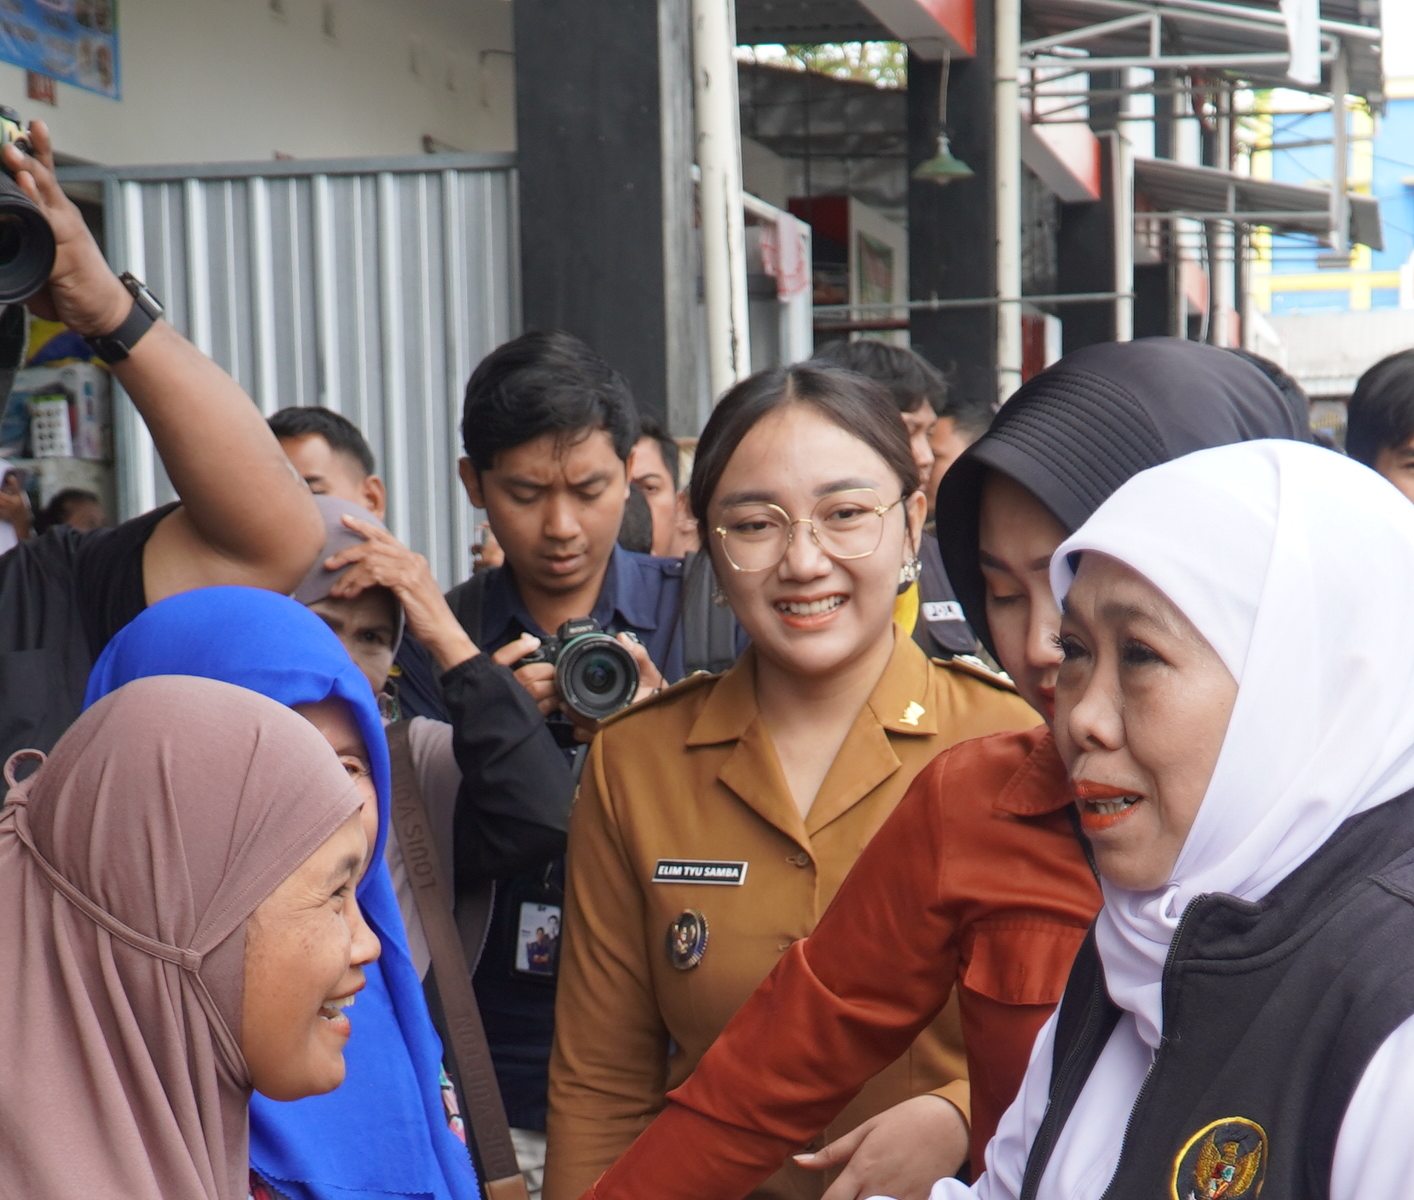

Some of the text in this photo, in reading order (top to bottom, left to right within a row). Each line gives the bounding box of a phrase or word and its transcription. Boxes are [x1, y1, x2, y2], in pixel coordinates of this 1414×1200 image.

[404, 823, 437, 890] LOUIS
[658, 865, 739, 878] ELIM TYU SAMBA
[483, 1123, 508, 1175] OUIS
